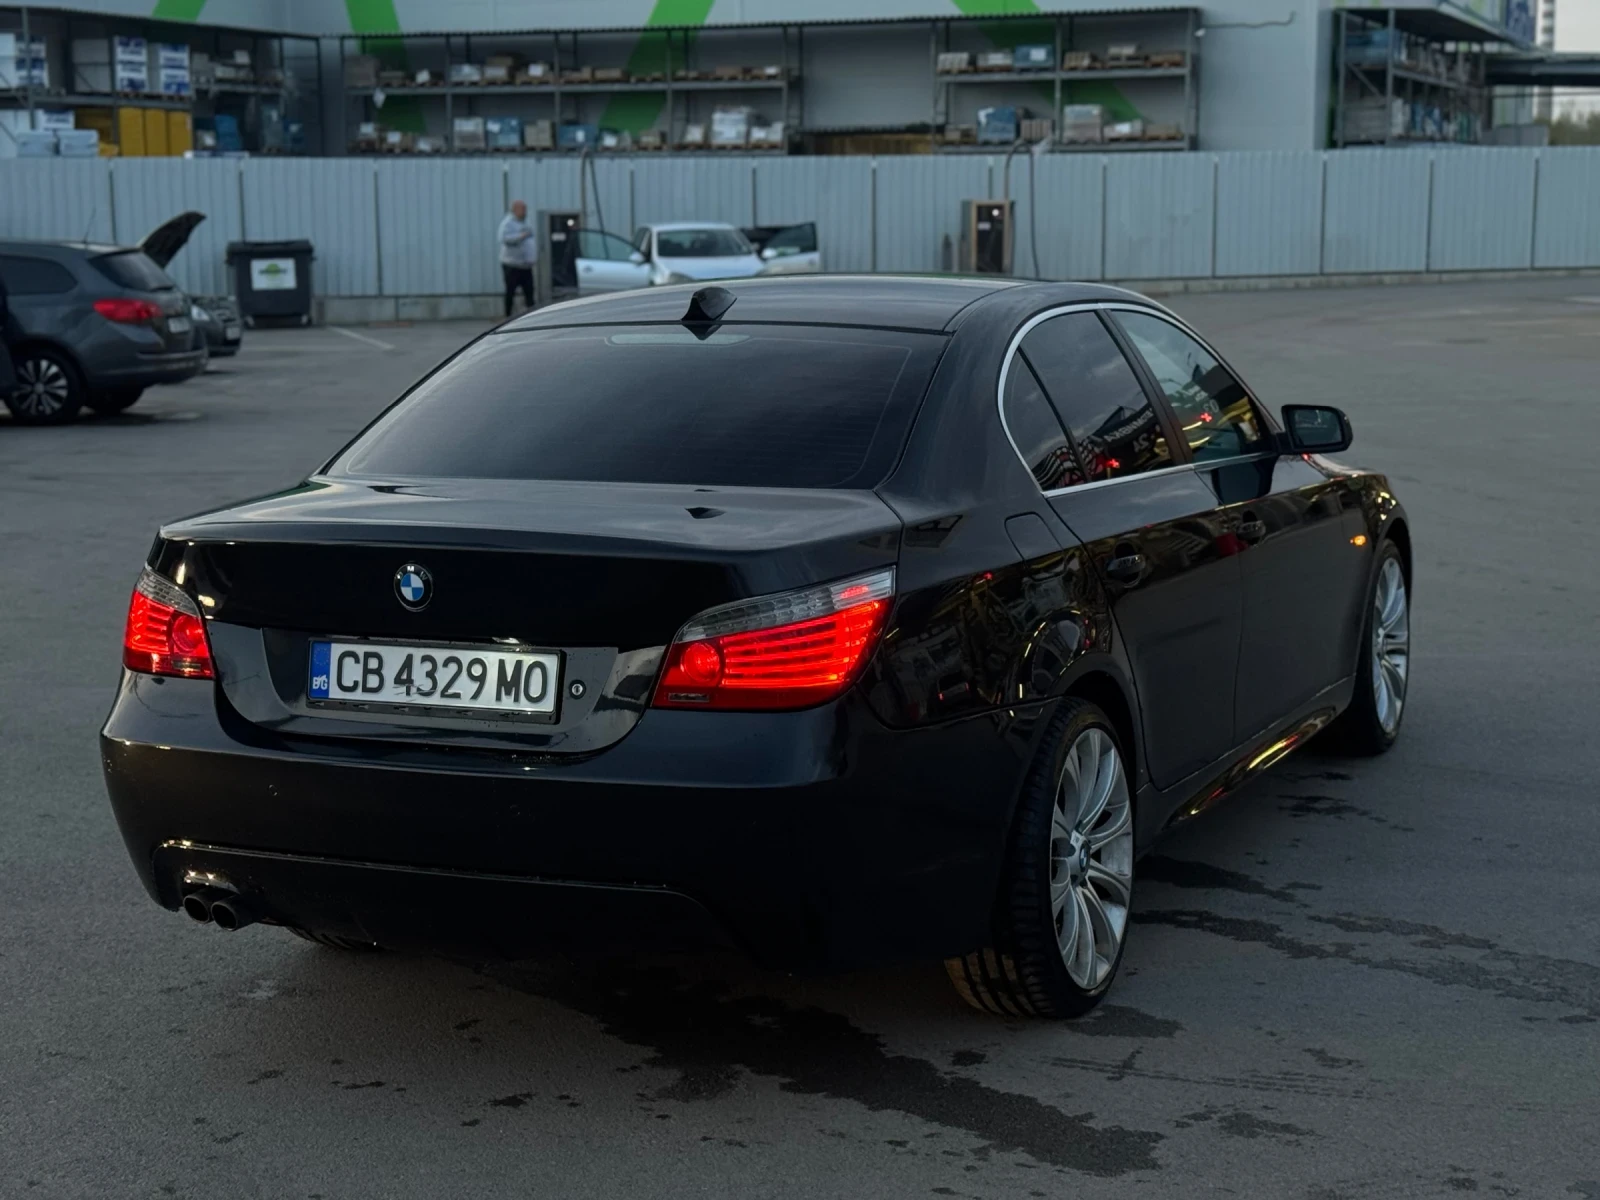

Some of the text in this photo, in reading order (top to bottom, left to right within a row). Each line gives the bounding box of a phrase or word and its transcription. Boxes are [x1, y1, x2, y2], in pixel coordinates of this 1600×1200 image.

[396, 565, 428, 581] BMW
[312, 674, 328, 690] BG
[336, 650, 548, 704] CB 4329 MO
